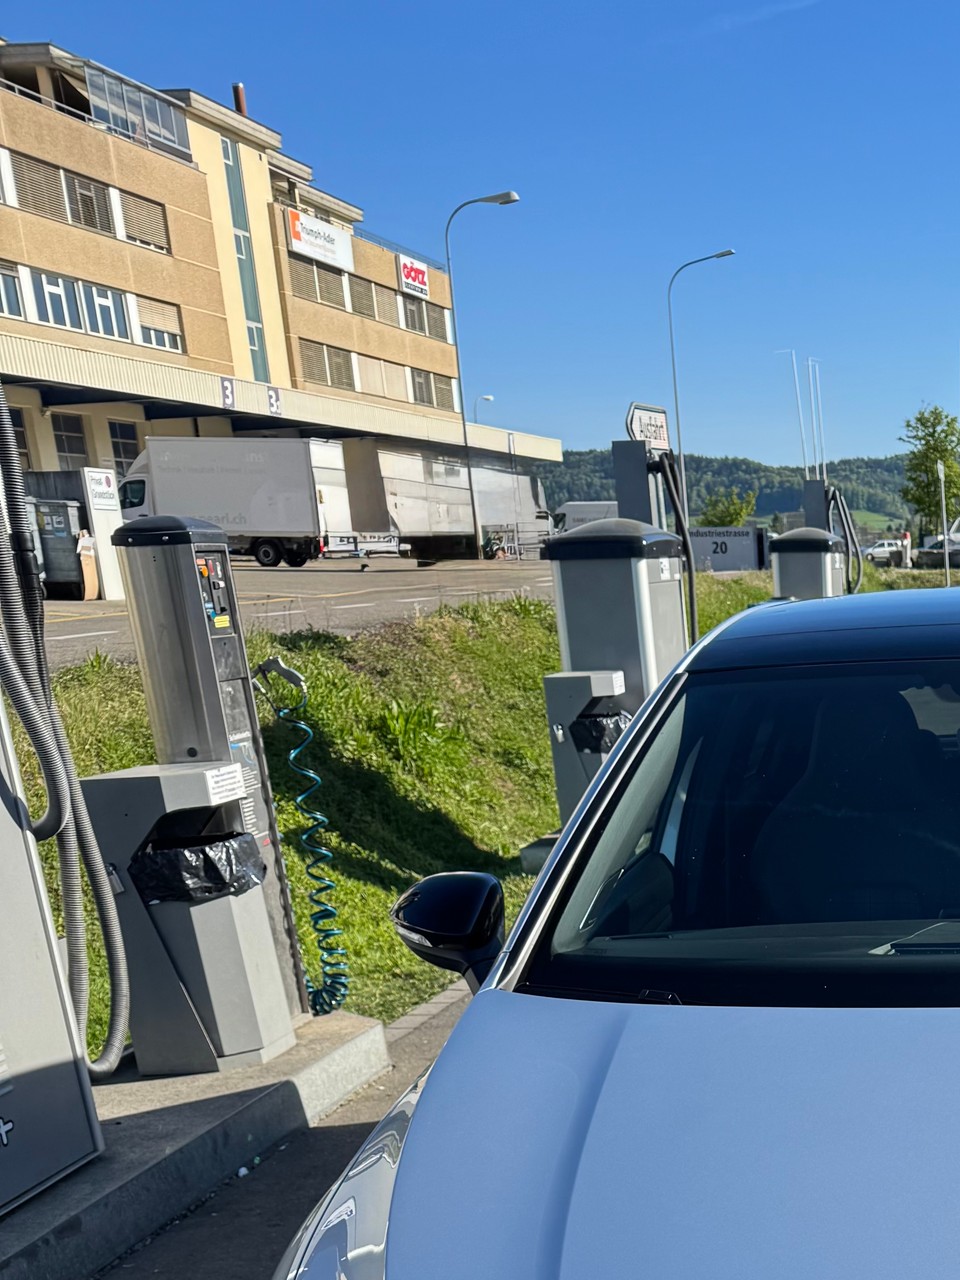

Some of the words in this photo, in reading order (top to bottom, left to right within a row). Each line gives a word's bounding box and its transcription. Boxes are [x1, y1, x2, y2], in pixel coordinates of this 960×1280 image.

[223, 380, 233, 405] 3
[638, 415, 666, 441] Ausfahrt
[689, 529, 750, 538] ndustriestrasse
[711, 541, 728, 555] 20
